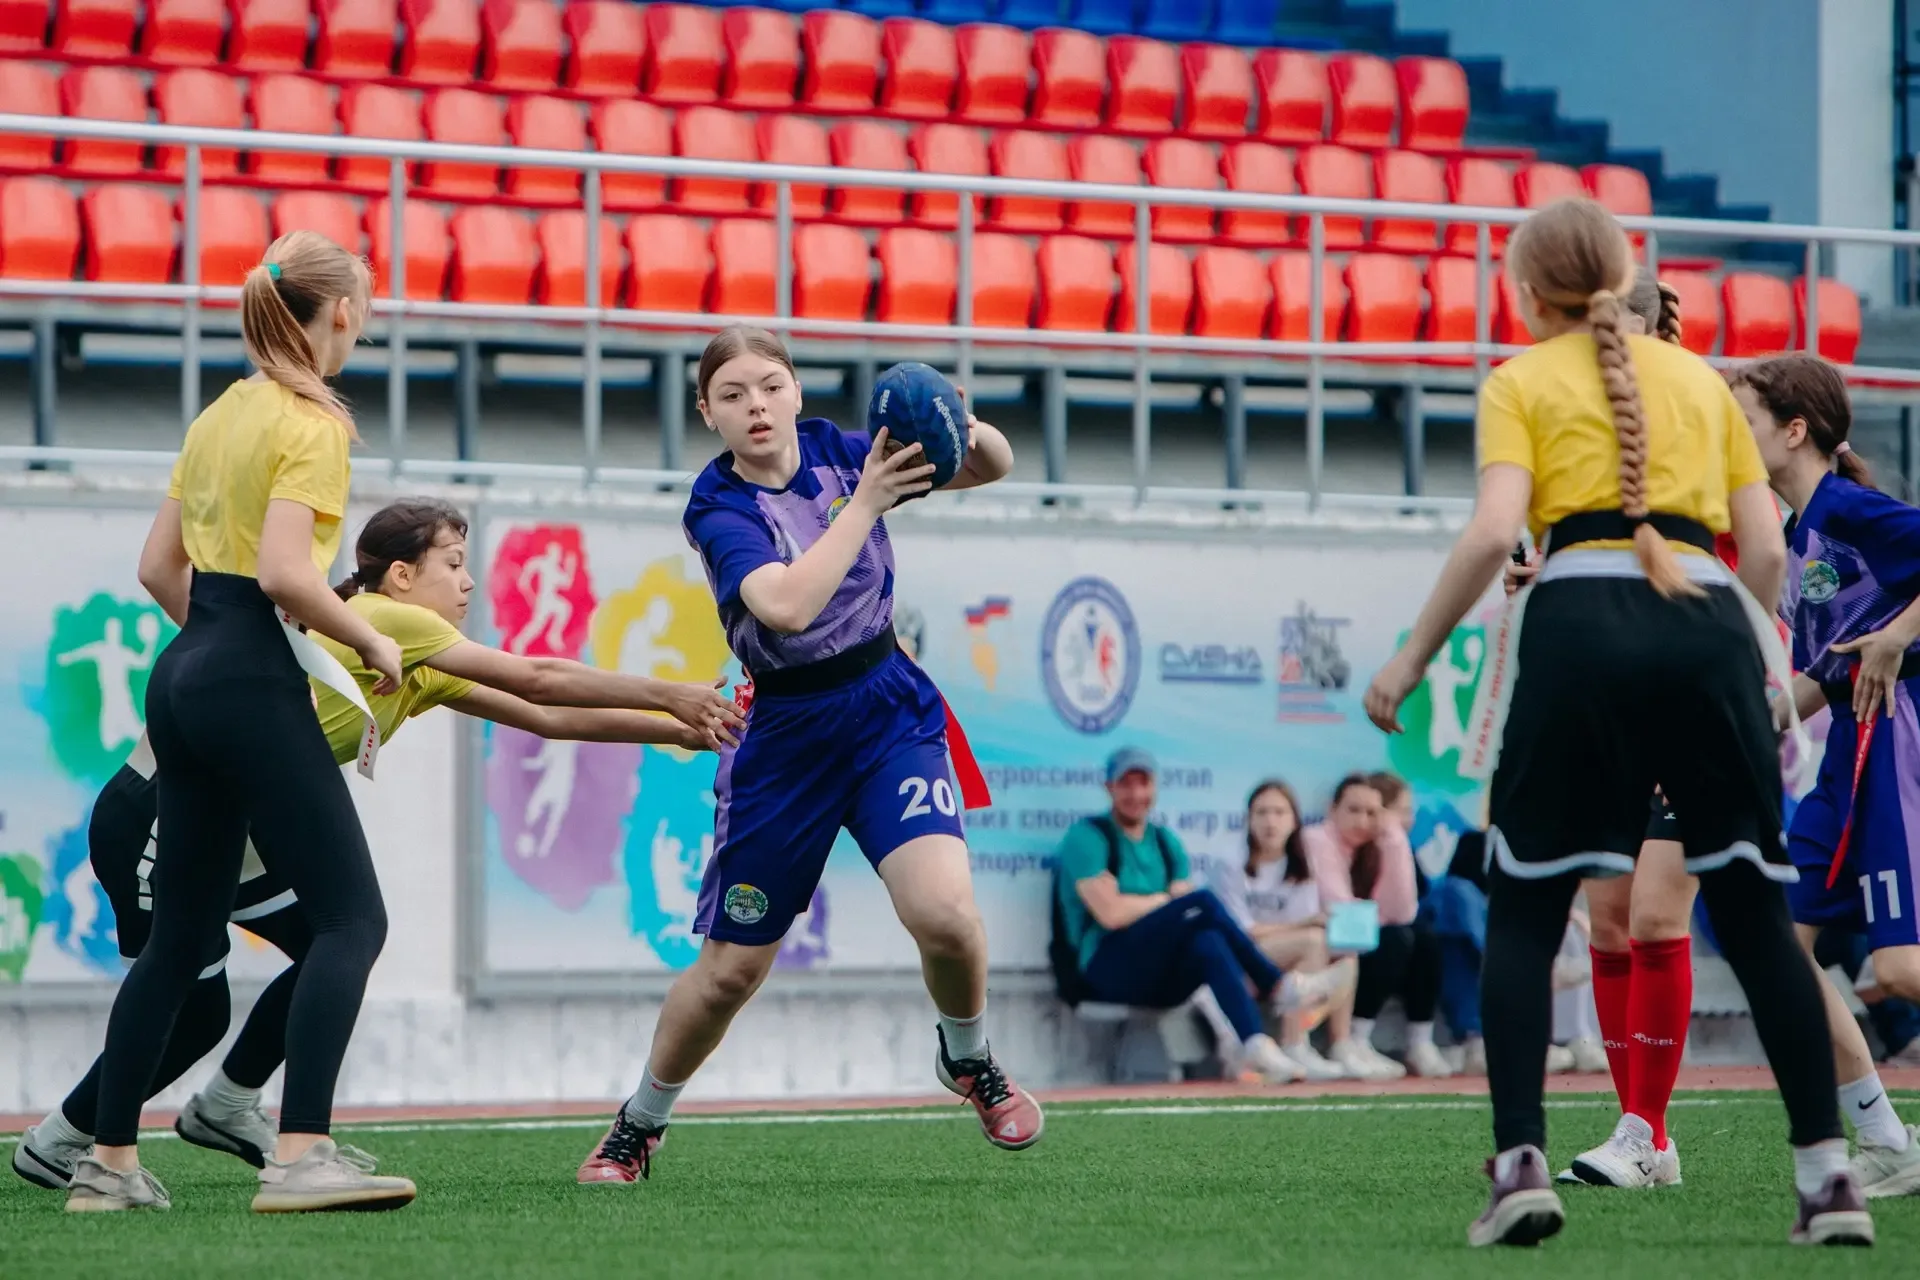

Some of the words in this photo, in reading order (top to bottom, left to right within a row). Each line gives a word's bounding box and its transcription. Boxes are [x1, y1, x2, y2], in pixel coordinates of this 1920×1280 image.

[898, 776, 956, 822] 20
[1164, 767, 1214, 787] этап
[1859, 869, 1902, 923] 11
